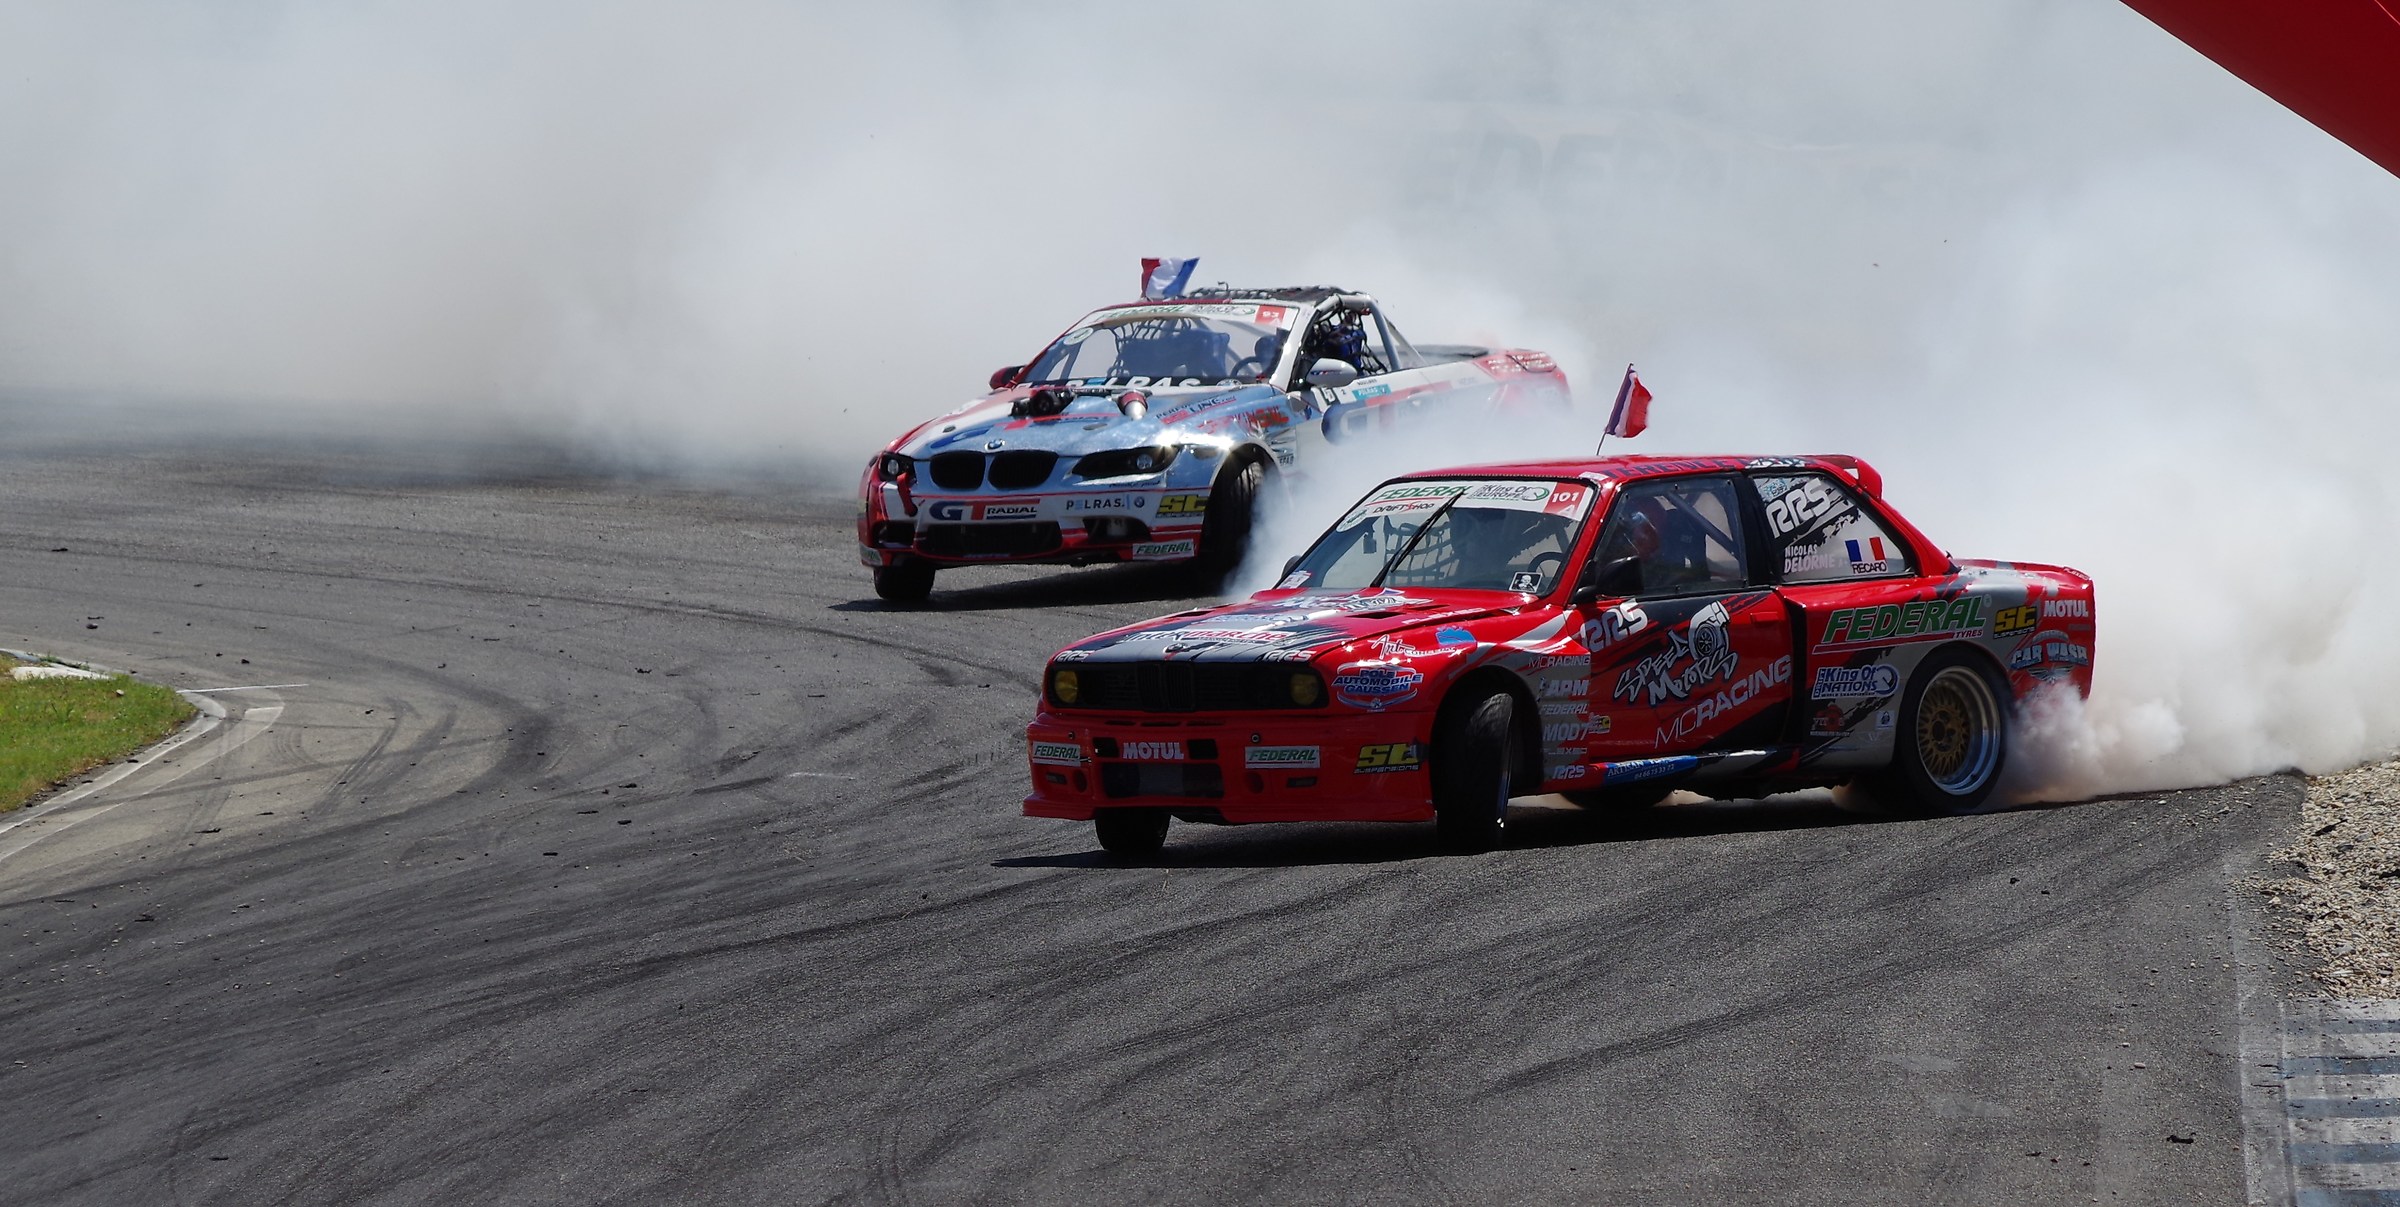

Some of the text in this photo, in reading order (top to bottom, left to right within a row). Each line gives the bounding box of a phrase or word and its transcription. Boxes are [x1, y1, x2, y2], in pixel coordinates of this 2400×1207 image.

[1551, 491, 1580, 503] 101
[929, 500, 1039, 521] GT RADIAL
[1765, 476, 1834, 539] RRS
[1135, 541, 1194, 555] FEDERAL
[1784, 543, 1819, 559] NICOLAS
[1783, 553, 1836, 574] DELORME
[1851, 561, 1887, 574] RECARO
[2043, 599, 2090, 618] MOTUL
[1581, 598, 1650, 652] RRS
[1820, 595, 1988, 645] FEDERAL
[1953, 629, 1984, 640] TYRES
[1528, 655, 1591, 668] MCRACING
[2010, 642, 2090, 667] CAR WASH
[1333, 673, 1424, 687] AUTOMOBILE
[1359, 668, 1396, 679] POLE
[1825, 666, 1877, 682] King Of
[1821, 680, 1879, 693] NATIONS
[1539, 703, 1590, 716] FEDERAL
[1654, 654, 1793, 750] MCRACING
[1033, 745, 1081, 760] FEDERAL
[1122, 742, 1185, 760] MOTUL
[1247, 748, 1319, 763] FEDERAL
